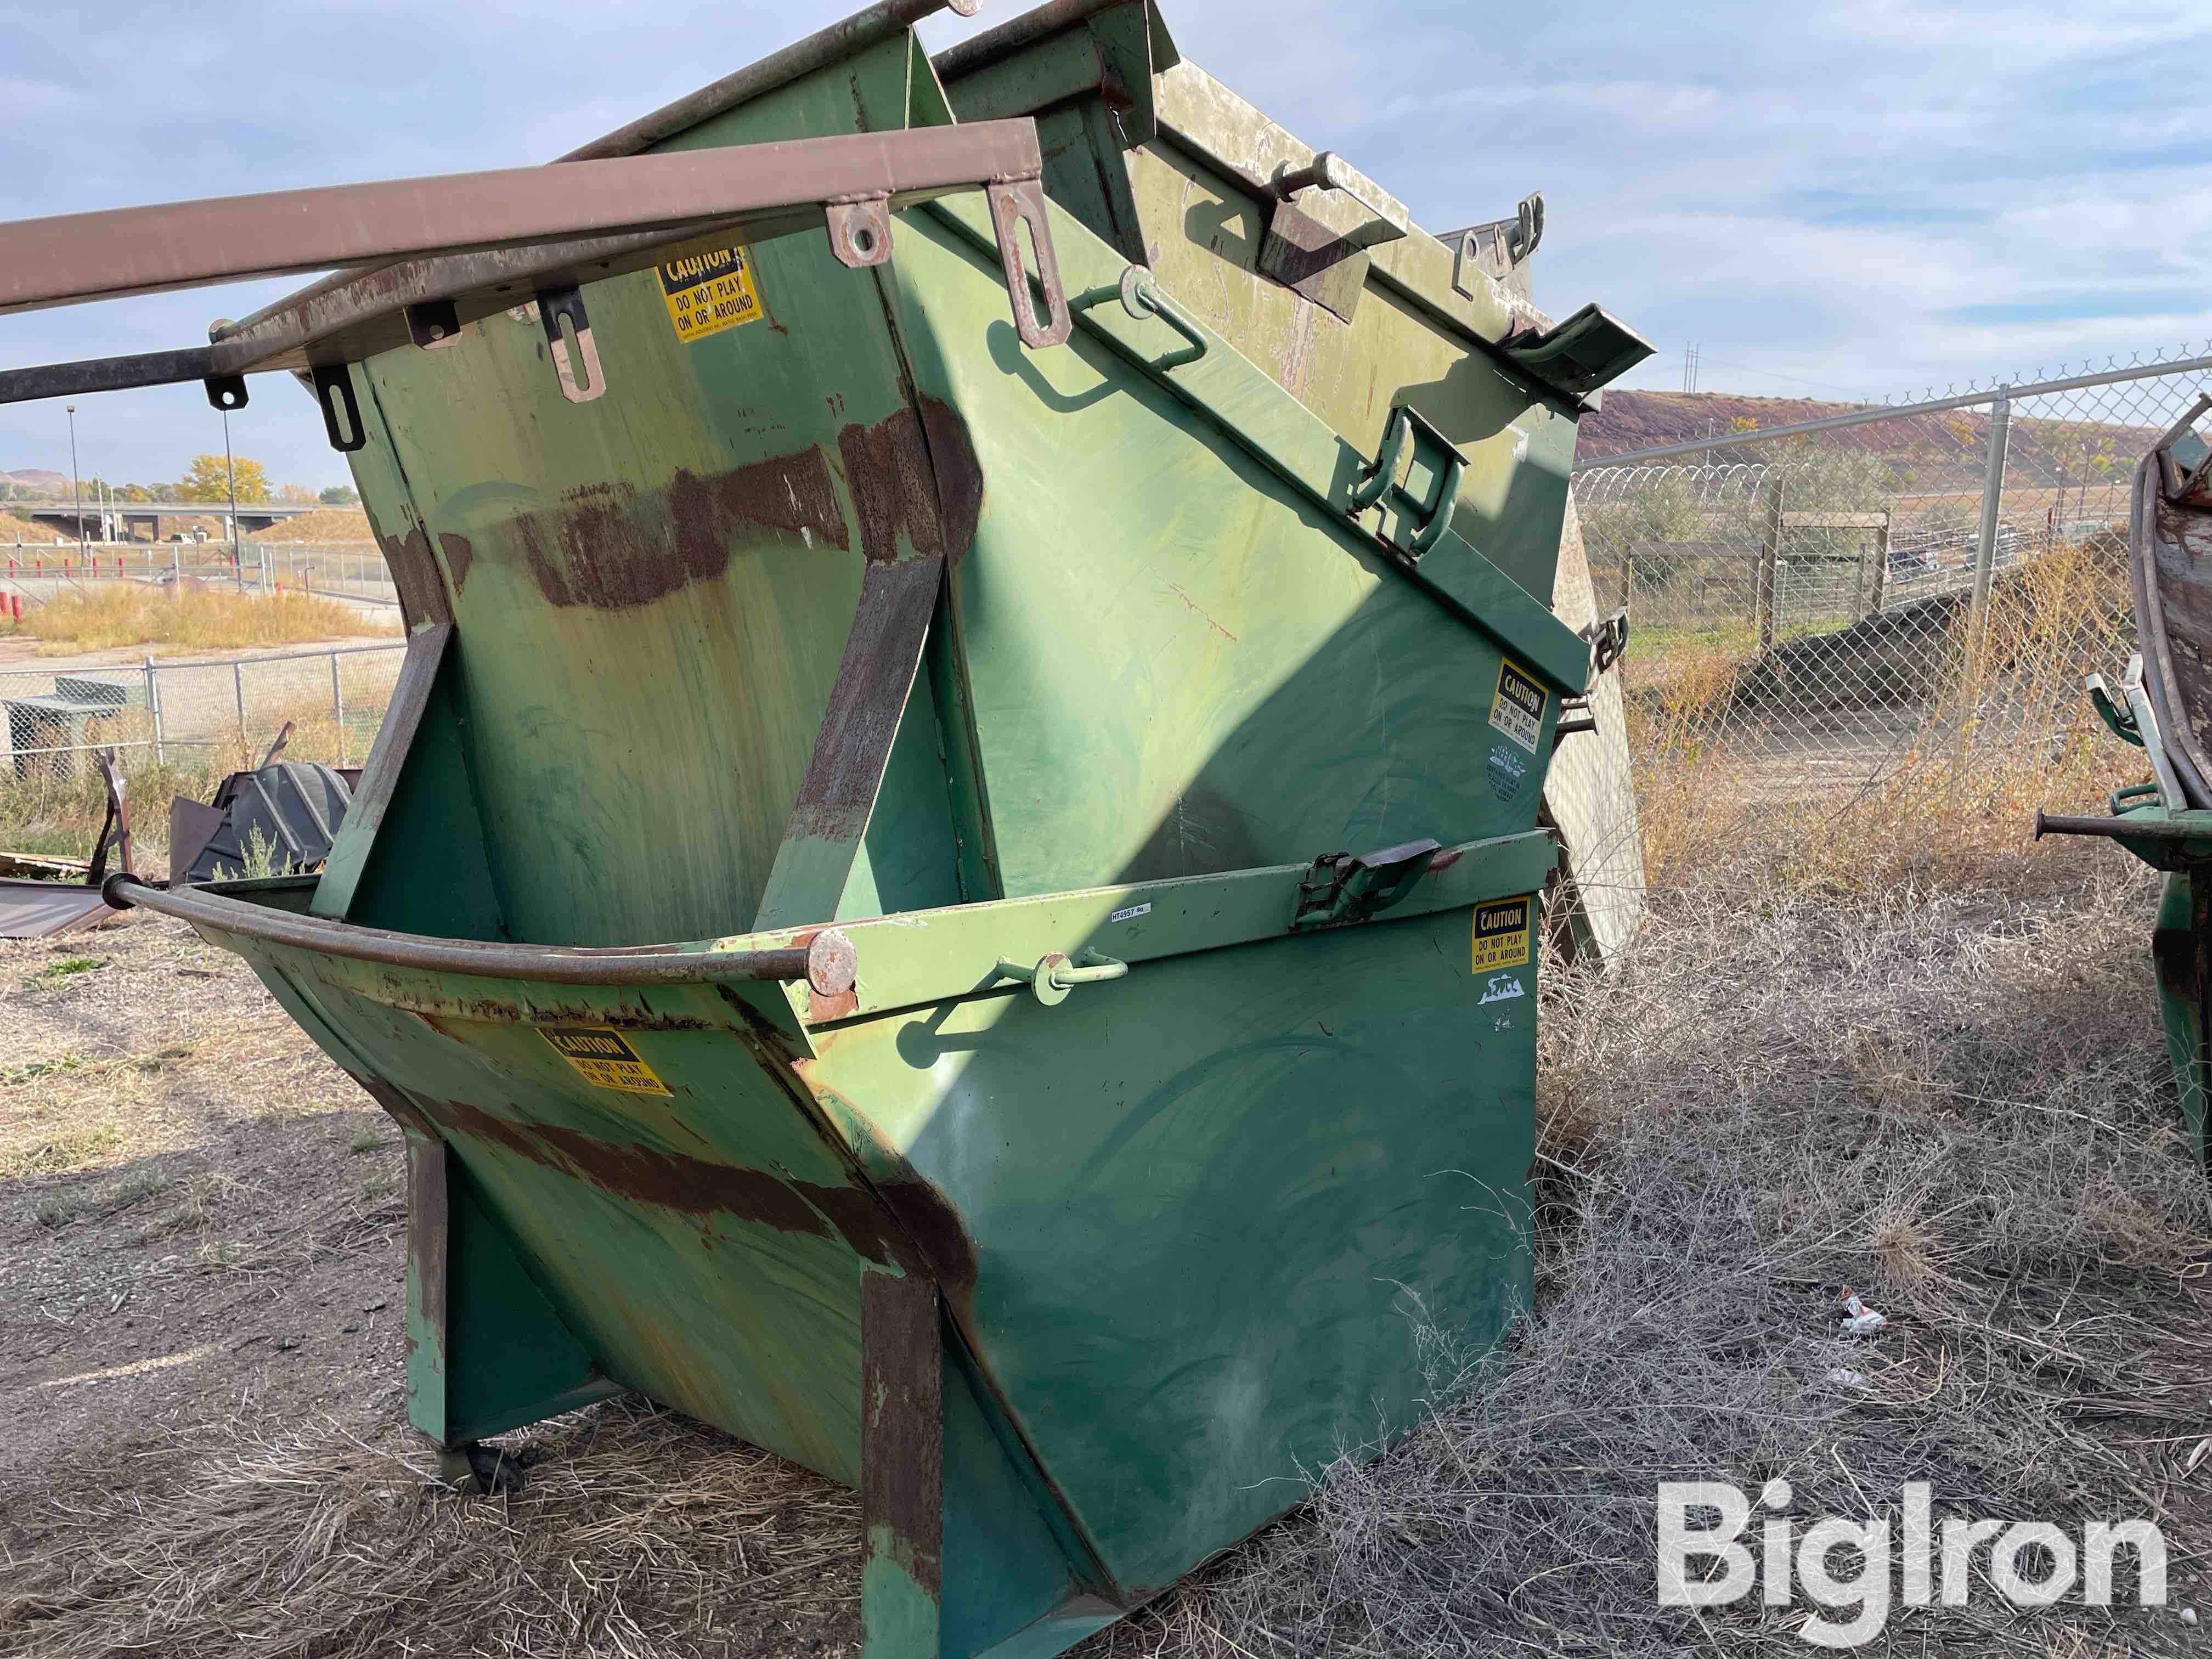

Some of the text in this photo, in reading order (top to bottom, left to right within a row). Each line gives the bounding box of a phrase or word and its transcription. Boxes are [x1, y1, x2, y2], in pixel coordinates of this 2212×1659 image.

[666, 249, 731, 281] CAUTION
[676, 276, 741, 312] DO NOT PLAY
[678, 315, 692, 331] ON
[696, 309, 710, 325] OR
[714, 294, 753, 320] AROUND
[1505, 674, 1540, 712] CAUTION
[1499, 698, 1536, 731] DO NOT PLAY
[1493, 709, 1502, 723] ON
[1504, 715, 1512, 729] OR
[1514, 723, 1536, 744] AROUND
[1113, 909, 1134, 921] HT4957
[1481, 909, 1521, 930] CAUTION
[1479, 934, 1523, 951] DO NOT PLAY
[1475, 954, 1484, 965] ON
[1488, 951, 1496, 962] OR
[1500, 947, 1525, 960] AROUND
[555, 1035, 625, 1054] CAUTION
[575, 1059, 644, 1075] DO NOT PLAY
[584, 1071, 600, 1081] ON
[601, 1073, 616, 1084] OR
[618, 1075, 659, 1088] AROUND
